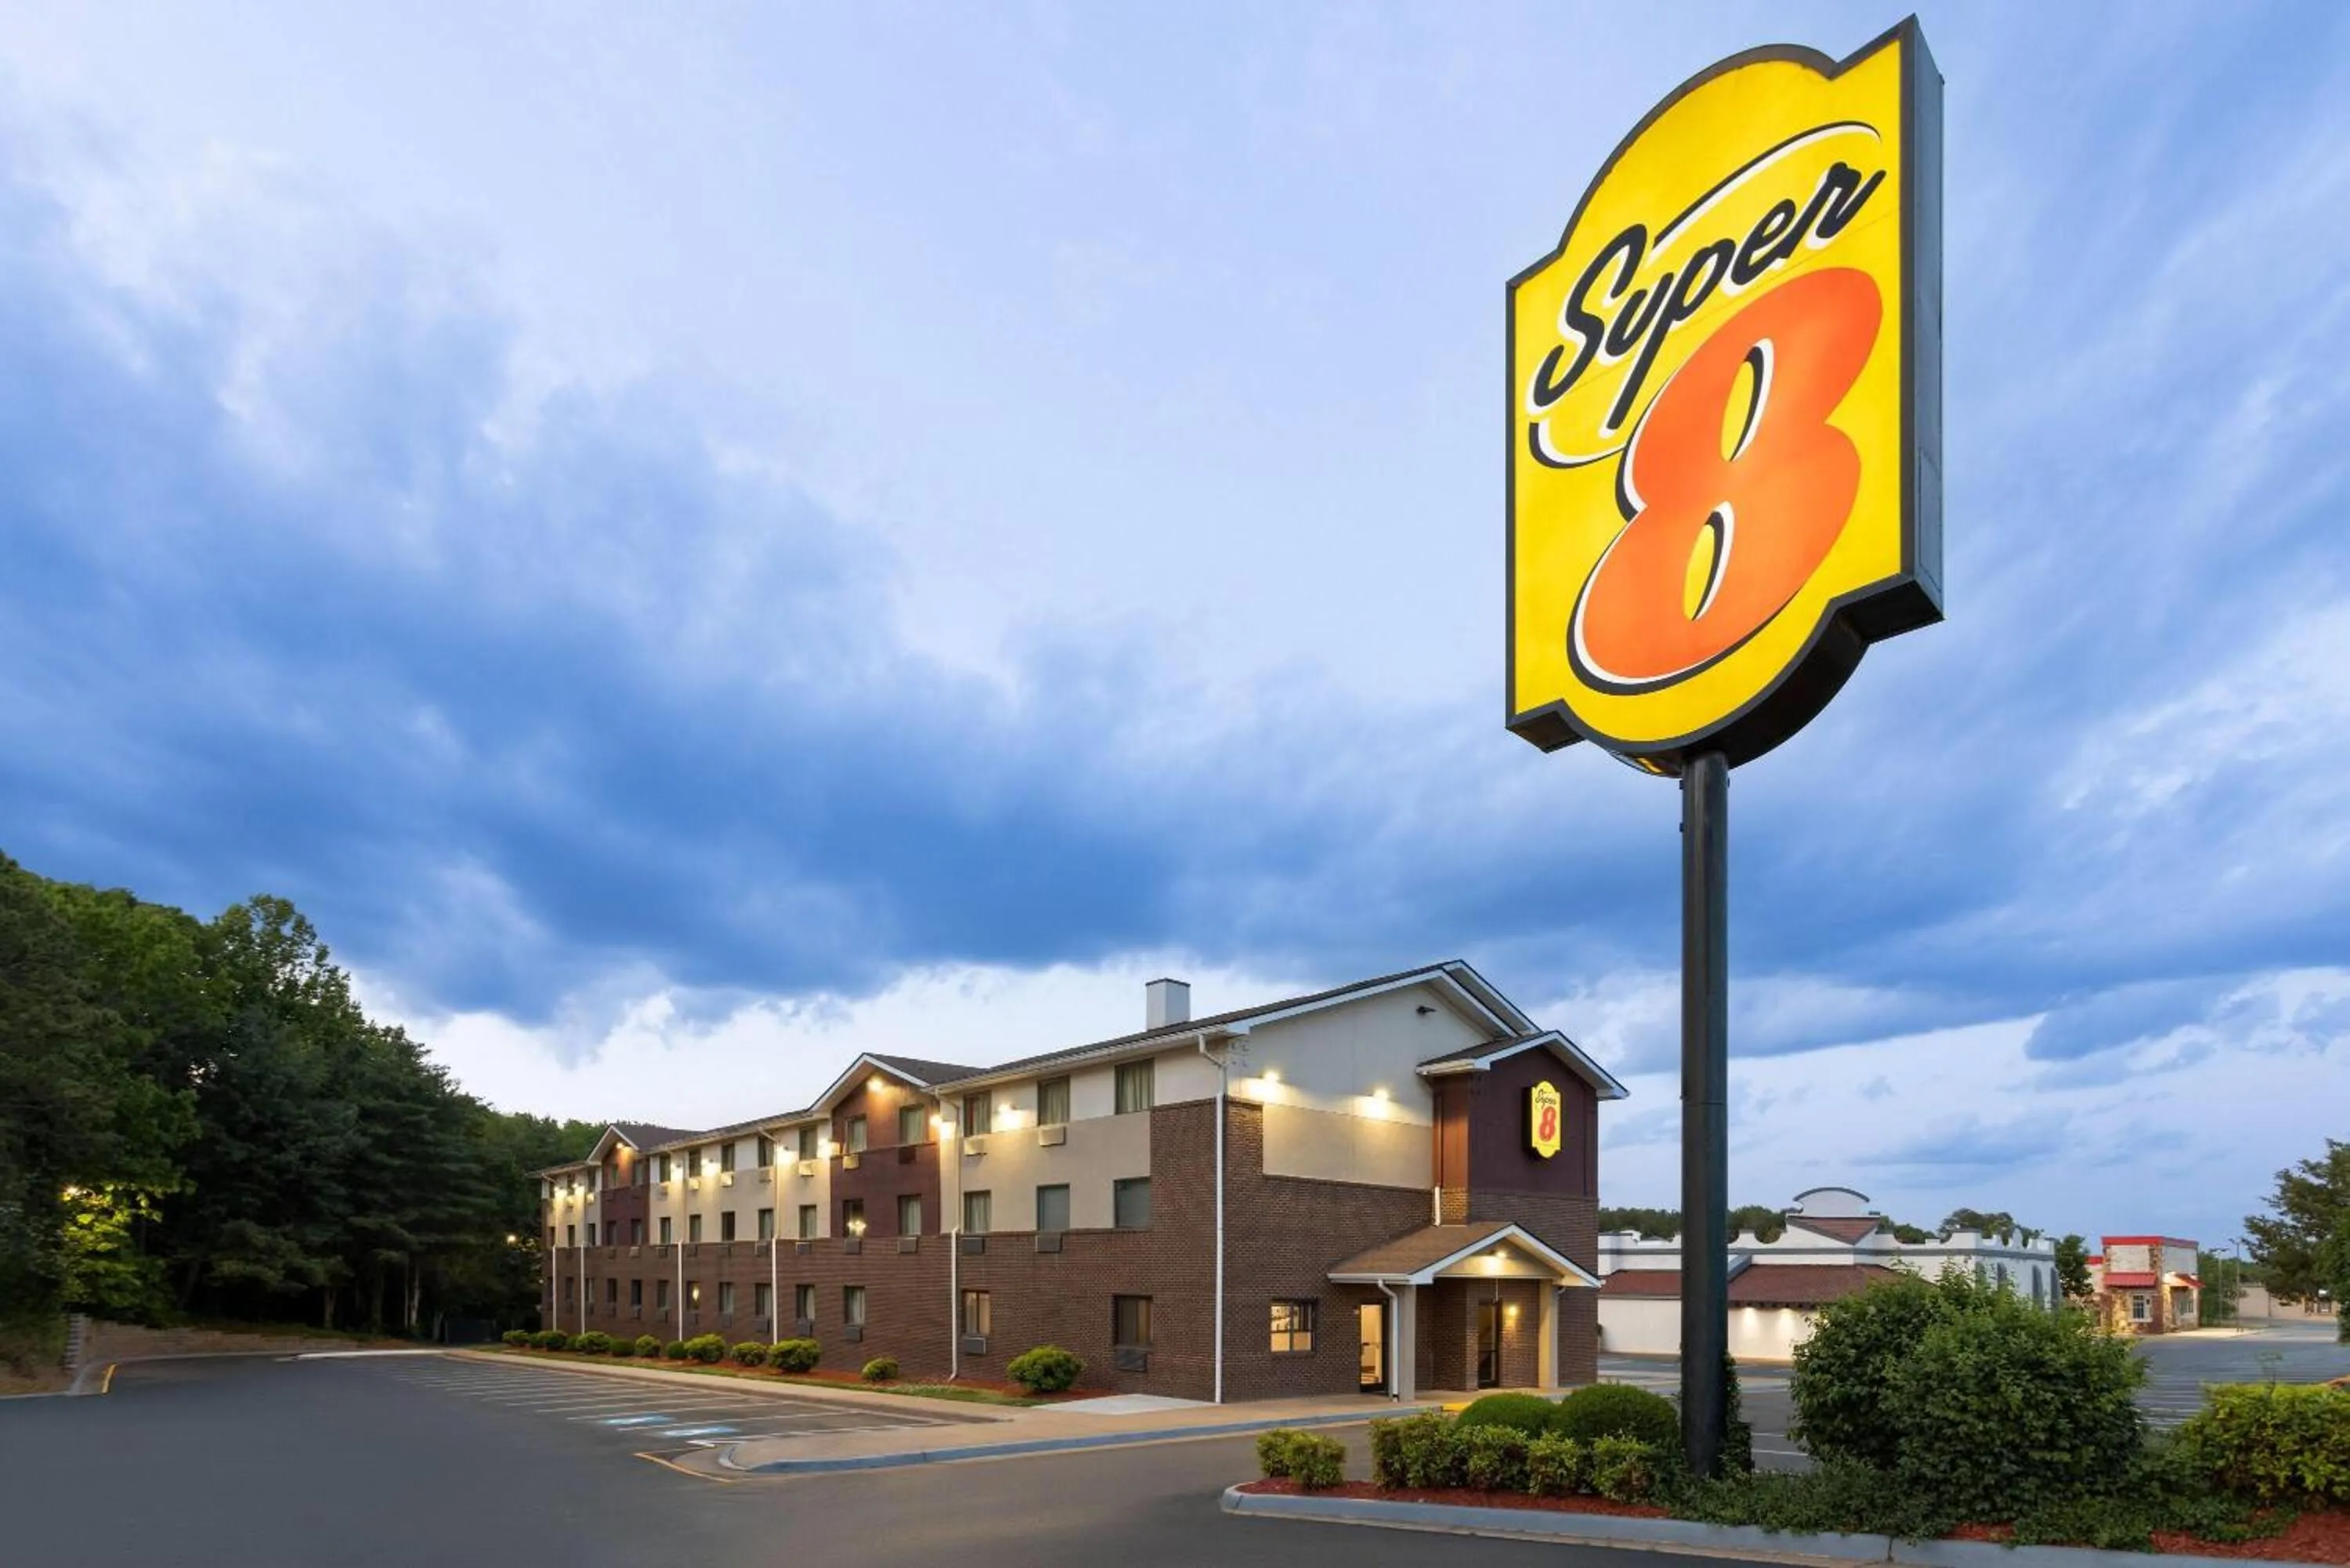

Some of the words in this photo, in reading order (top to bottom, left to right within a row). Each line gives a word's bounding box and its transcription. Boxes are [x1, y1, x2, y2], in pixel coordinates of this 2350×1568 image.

[1531, 161, 1886, 434] Super
[1568, 267, 1883, 694] 8
[1539, 1106, 1556, 1141] 8
